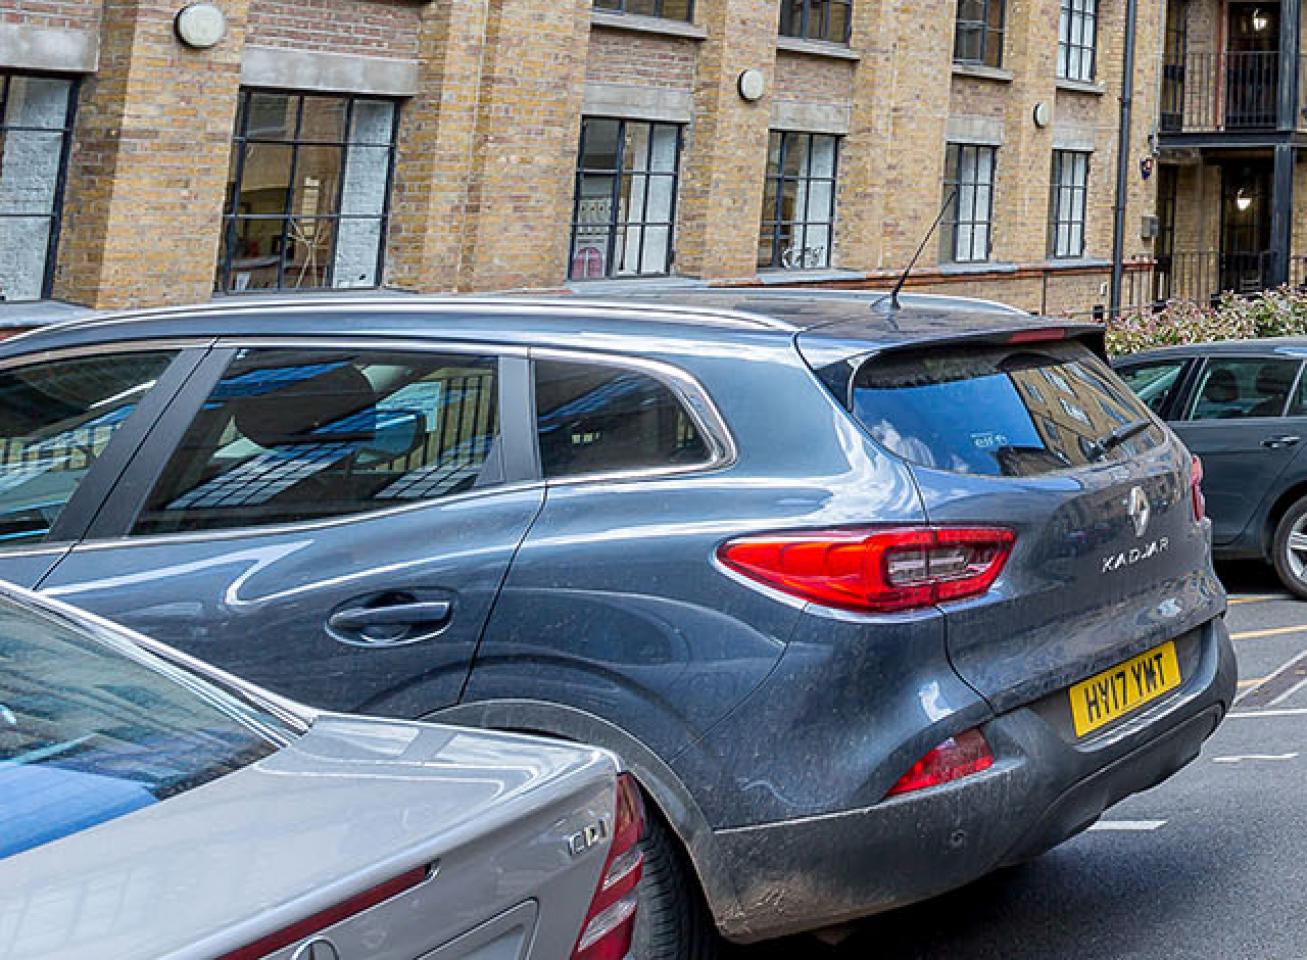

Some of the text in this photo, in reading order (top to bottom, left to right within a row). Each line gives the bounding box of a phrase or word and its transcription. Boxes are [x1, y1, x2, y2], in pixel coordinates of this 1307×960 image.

[1102, 536, 1169, 573] KADJAR
[1083, 653, 1166, 724] HY17 YMT
[567, 817, 608, 857] CDI
